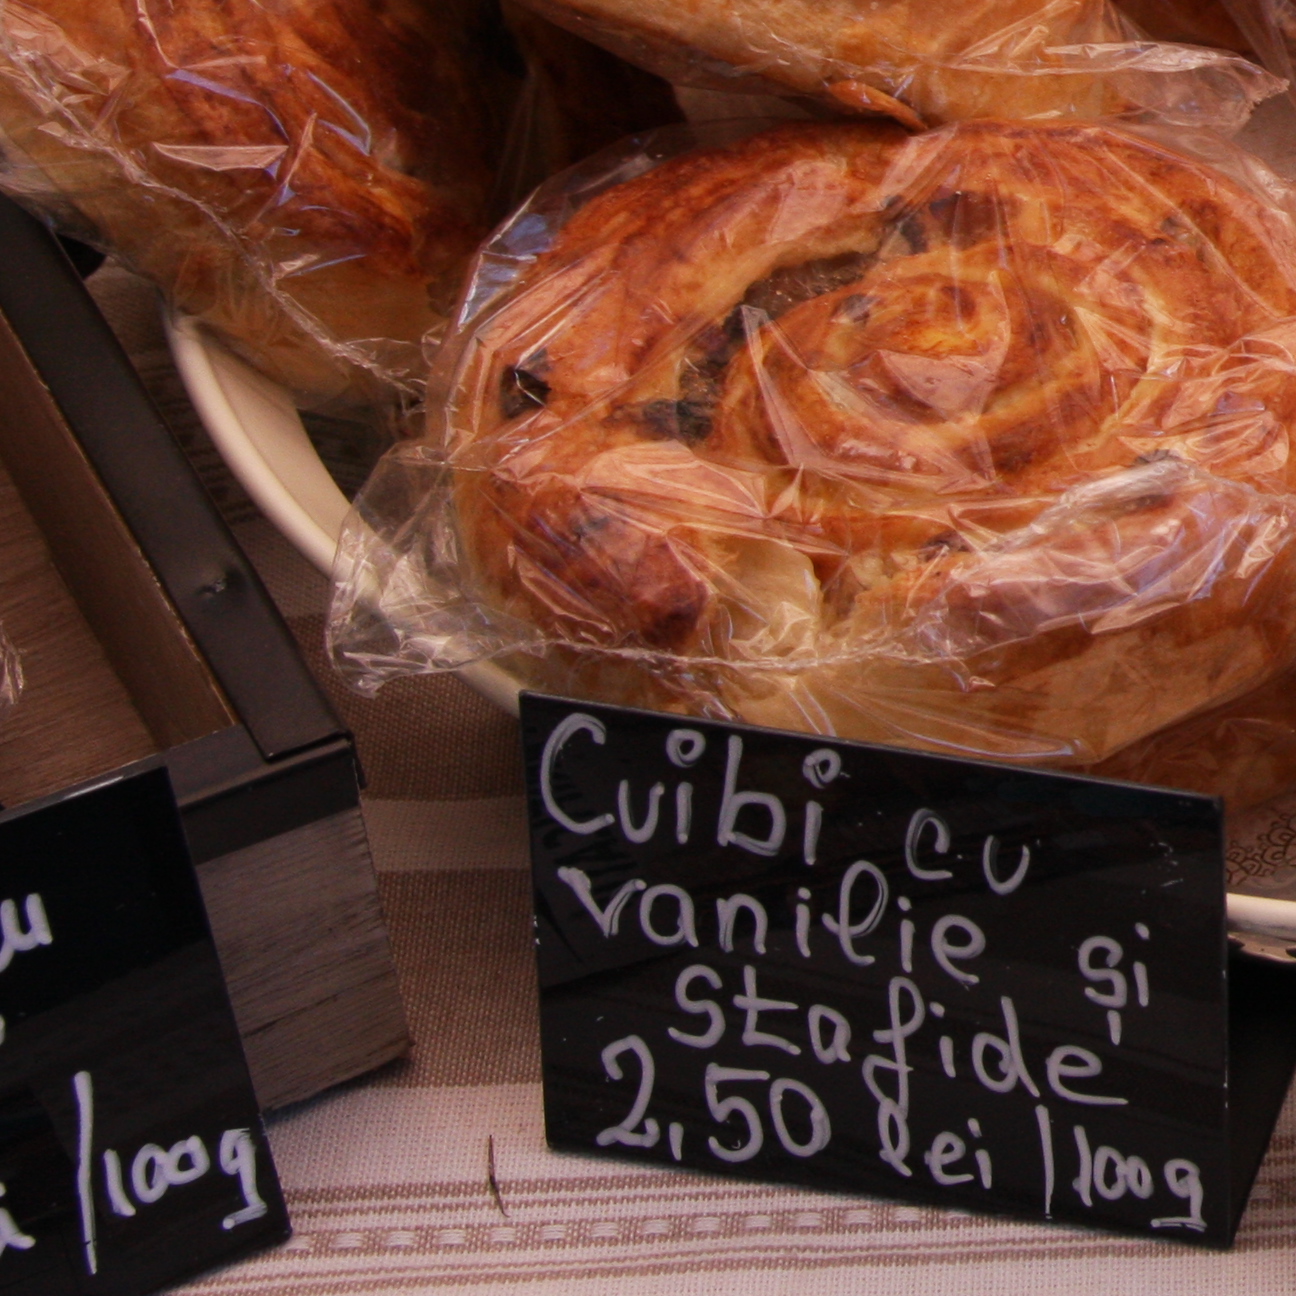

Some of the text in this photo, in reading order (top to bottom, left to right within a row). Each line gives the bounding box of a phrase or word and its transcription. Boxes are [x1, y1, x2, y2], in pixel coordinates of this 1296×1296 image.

[540, 713, 1029, 894] Cuibi cu
[0, 893, 52, 972] u
[557, 860, 985, 986] vanilie
[668, 964, 1128, 1104] stafide
[597, 1035, 830, 1162] 2,50
[878, 1099, 993, 1189] lei
